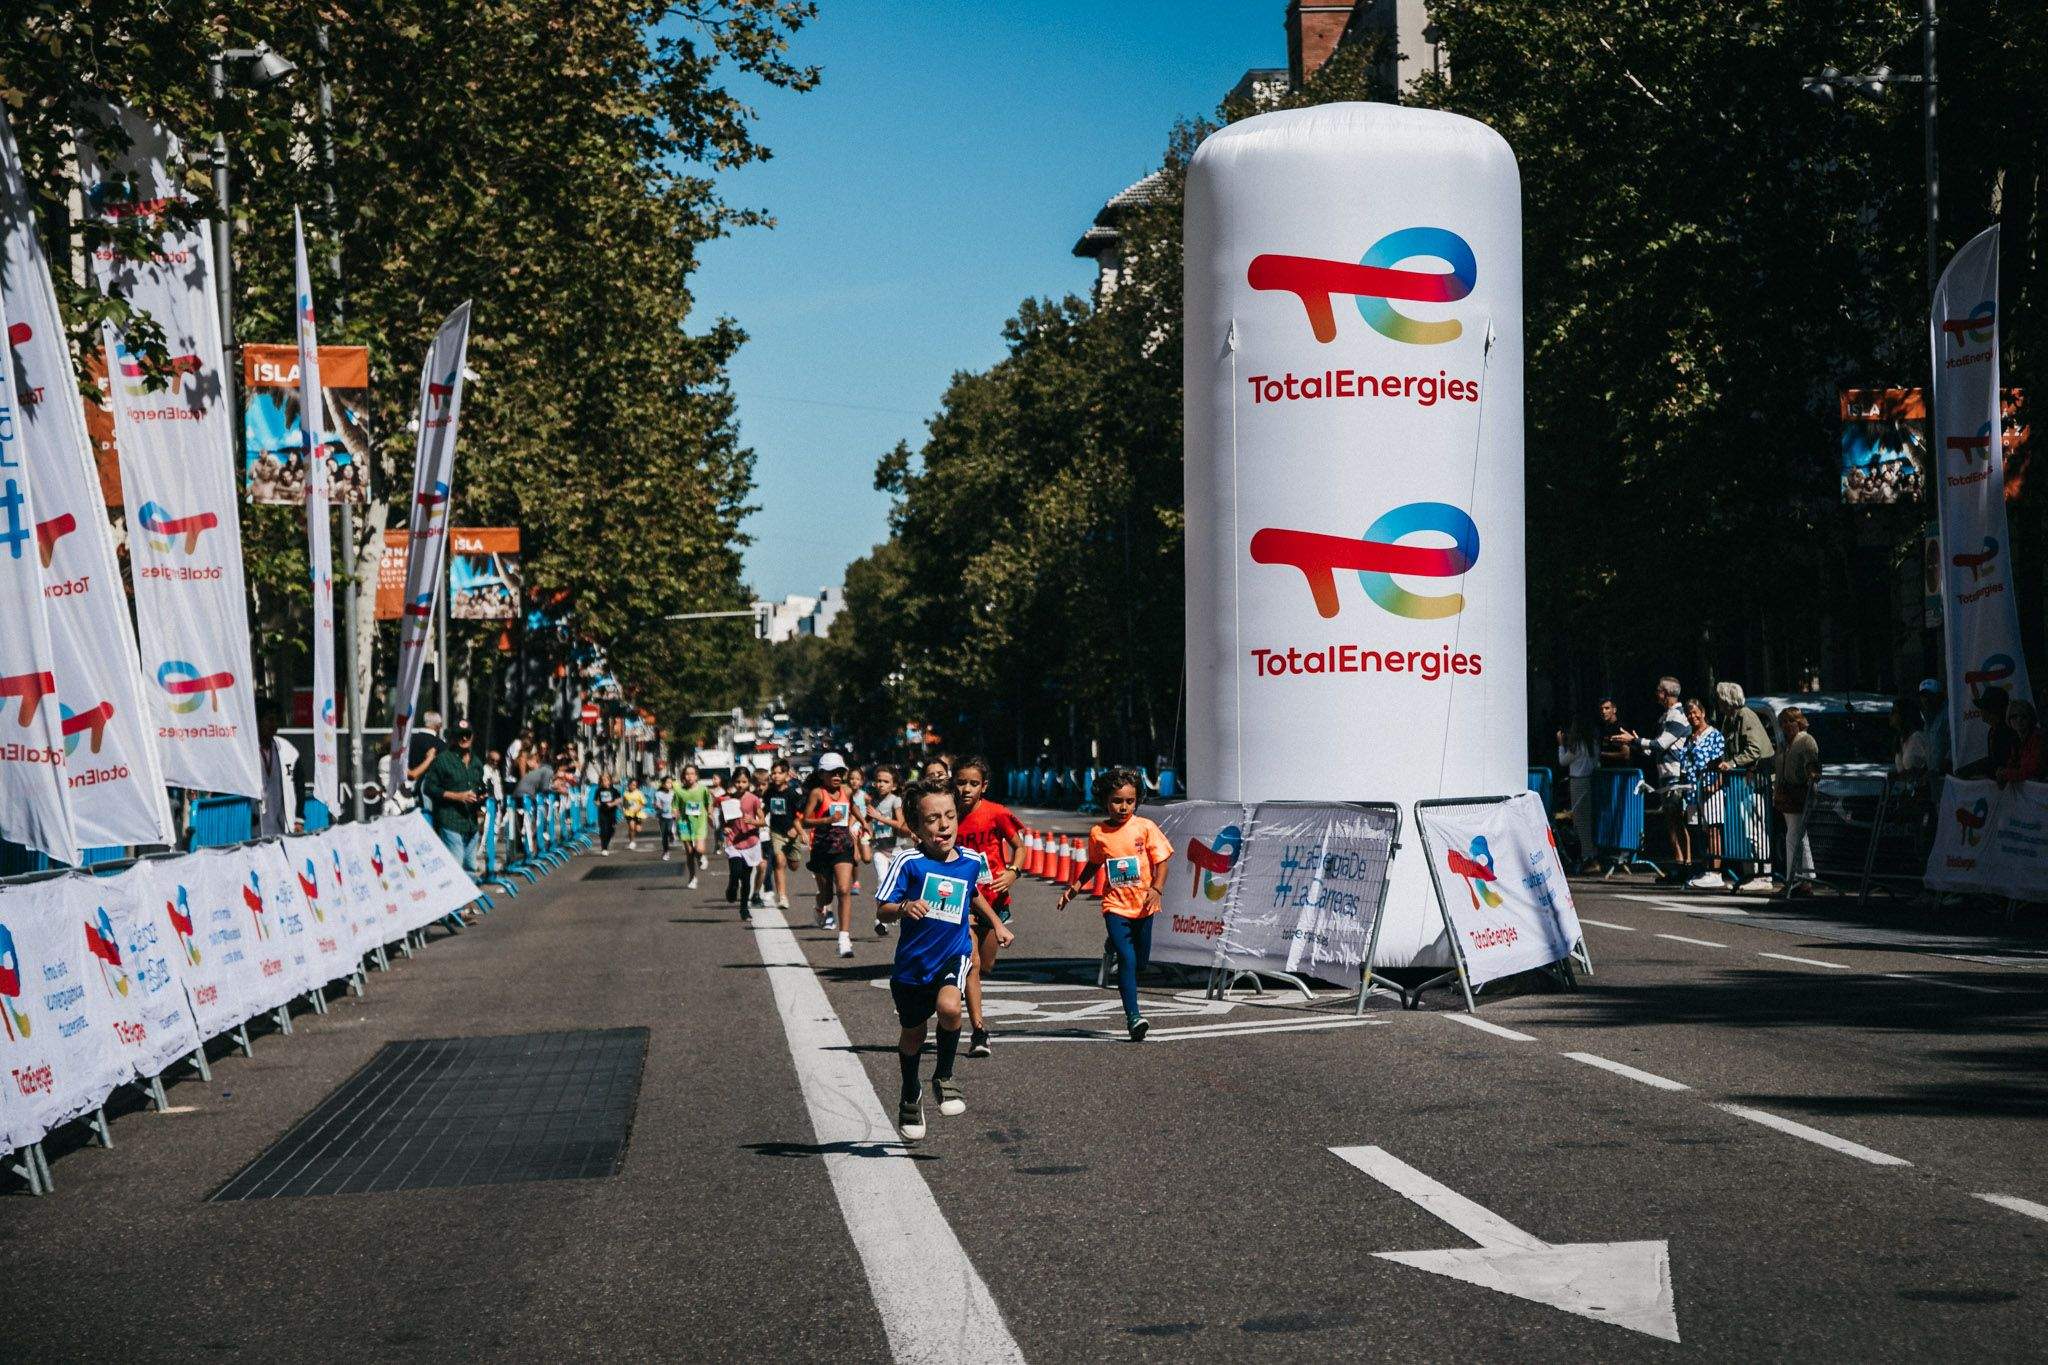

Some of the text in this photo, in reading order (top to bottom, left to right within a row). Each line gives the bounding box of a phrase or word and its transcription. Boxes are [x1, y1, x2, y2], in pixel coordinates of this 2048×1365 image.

[253, 363, 301, 382] ISLA
[1248, 370, 1479, 406] TotalEnergies
[1251, 645, 1482, 681] TotalEnergies
